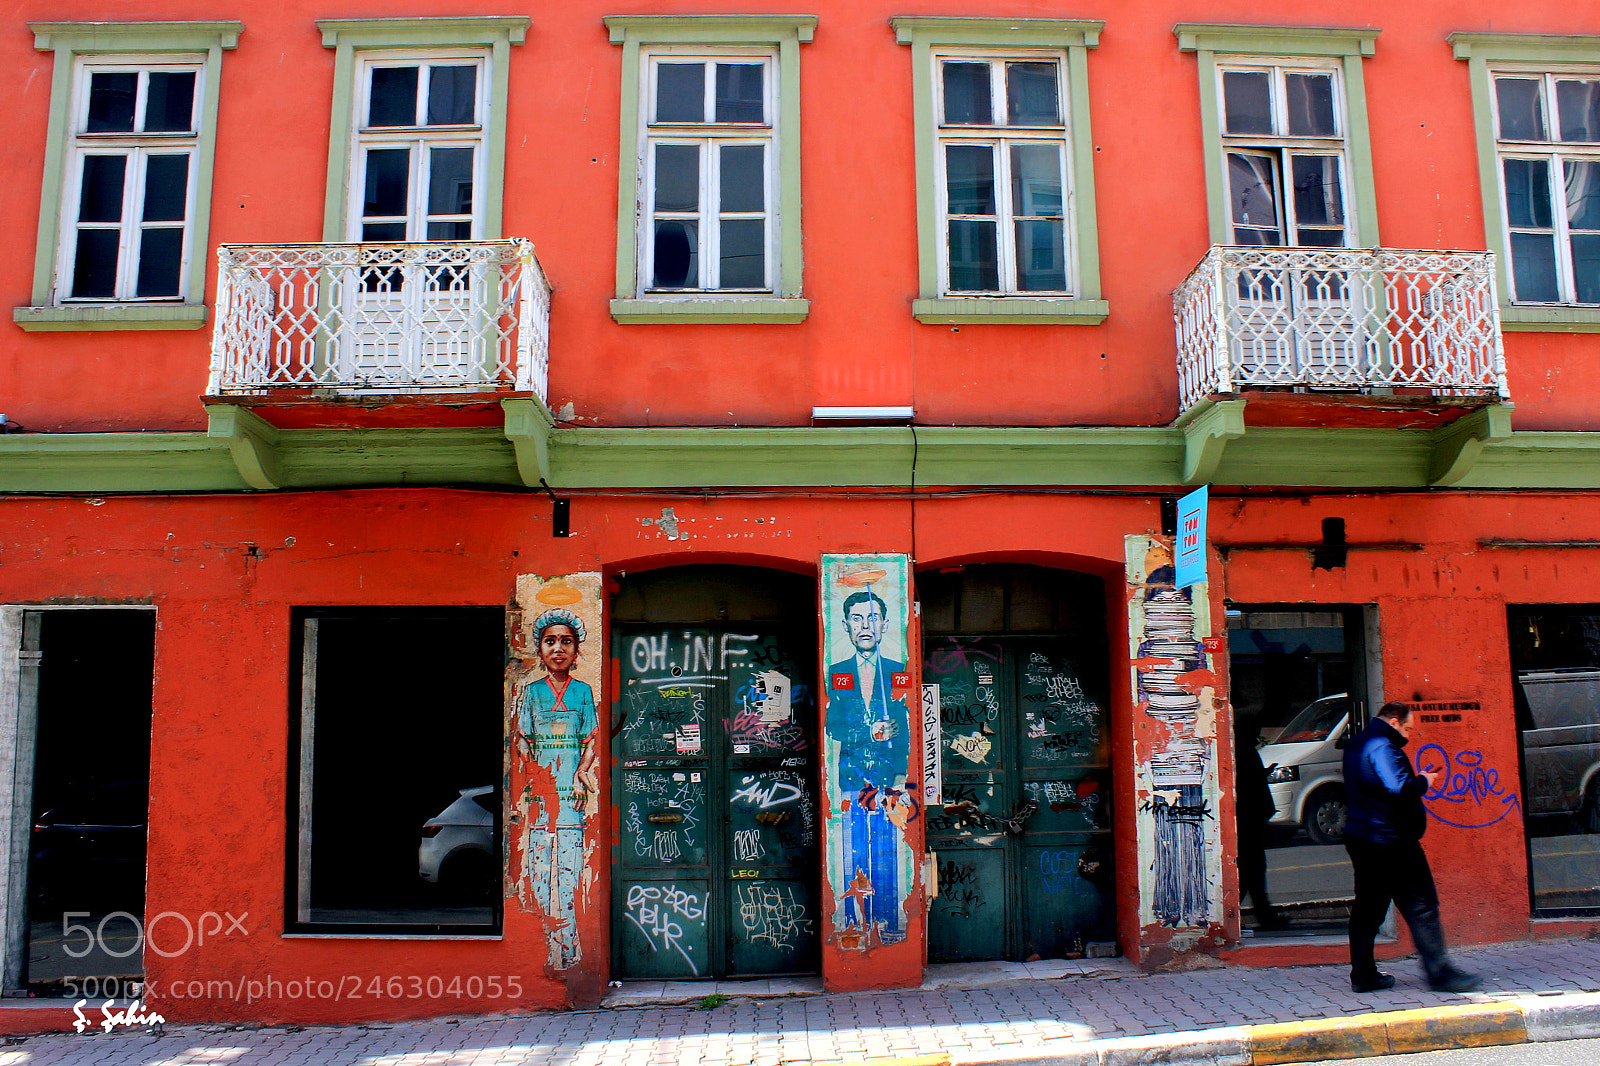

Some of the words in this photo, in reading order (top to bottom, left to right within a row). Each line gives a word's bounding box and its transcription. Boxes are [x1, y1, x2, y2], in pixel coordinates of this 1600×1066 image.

[1185, 517, 1198, 533] TOM
[1183, 532, 1198, 549] TOM
[731, 869, 760, 878] LEO!
